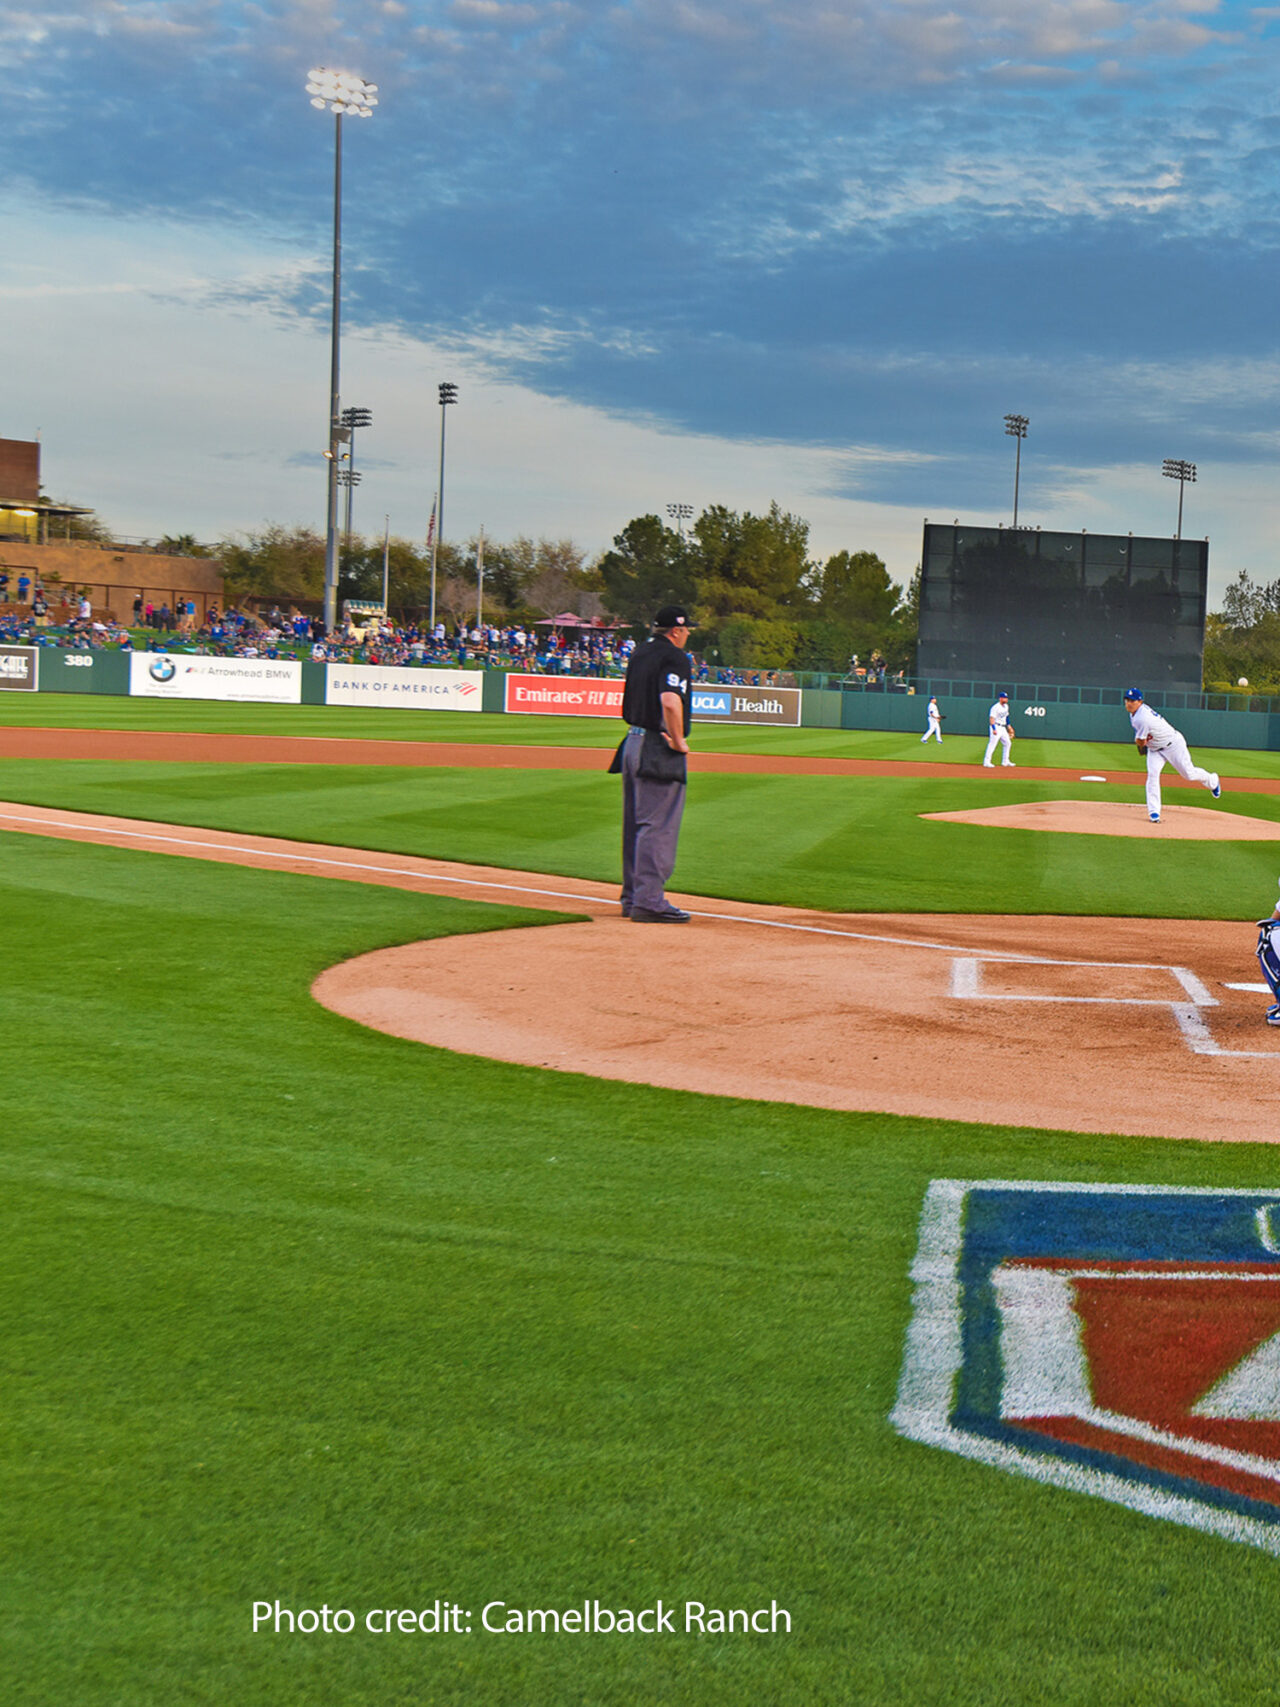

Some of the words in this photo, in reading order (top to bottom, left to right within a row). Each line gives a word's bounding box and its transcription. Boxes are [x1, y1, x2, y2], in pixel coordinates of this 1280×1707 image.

[64, 655, 93, 667] 380
[208, 667, 263, 678] Arrowhead
[266, 669, 293, 679] BMW
[333, 680, 369, 691] BANK
[373, 682, 388, 691] OF
[392, 684, 450, 694] AMERICA
[667, 673, 688, 694] 94
[516, 687, 583, 704] Emirates
[588, 690, 606, 705] FLY
[691, 696, 726, 710] UCLA
[734, 697, 784, 714] Health
[1024, 706, 1046, 717] 410
